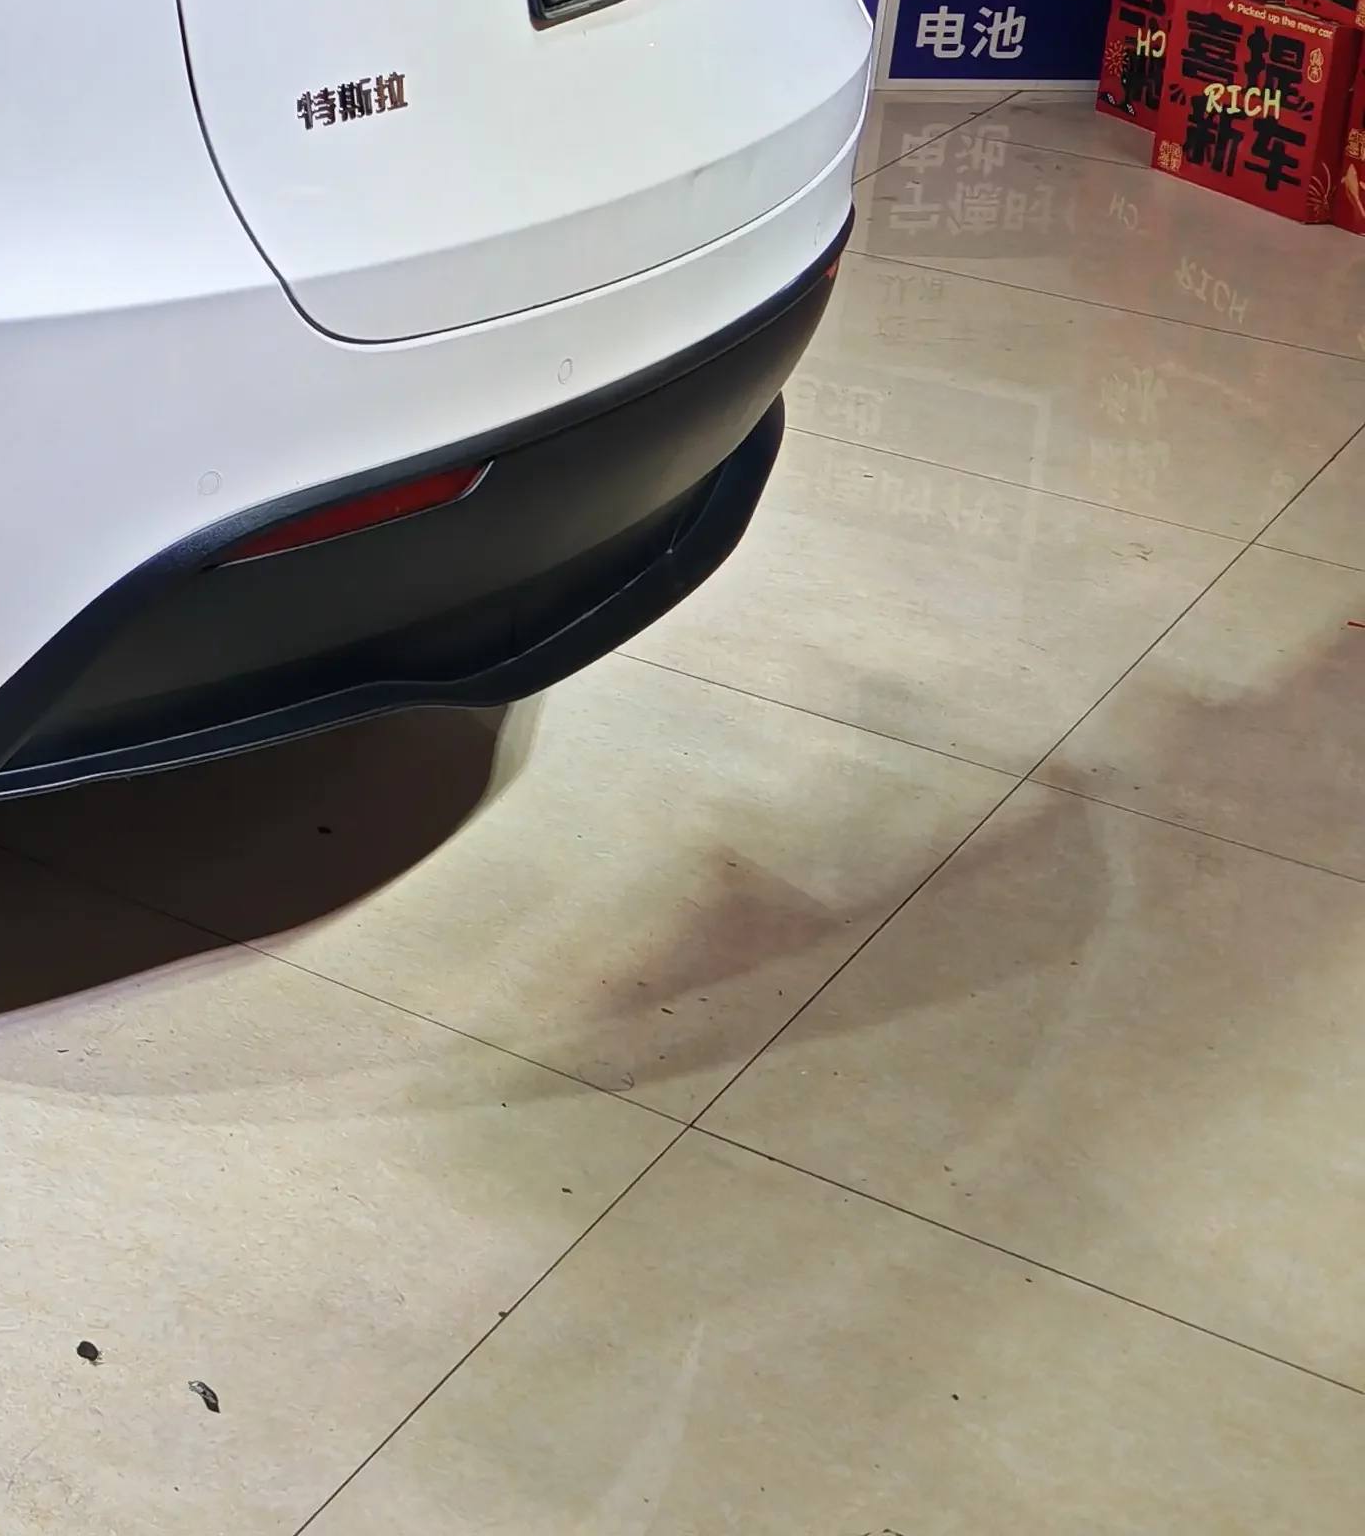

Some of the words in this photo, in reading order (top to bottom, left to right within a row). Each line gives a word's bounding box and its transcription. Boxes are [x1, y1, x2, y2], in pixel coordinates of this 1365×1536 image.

[915, 5, 1028, 60] 电池
[1236, 2, 1267, 21] Picked
[1267, 10, 1281, 26] up
[1281, 13, 1297, 29] the
[1296, 20, 1317, 34] new
[296, 71, 409, 130] 特斯拉
[1204, 82, 1282, 120] RICH
[1183, 95, 1307, 192] 新车
